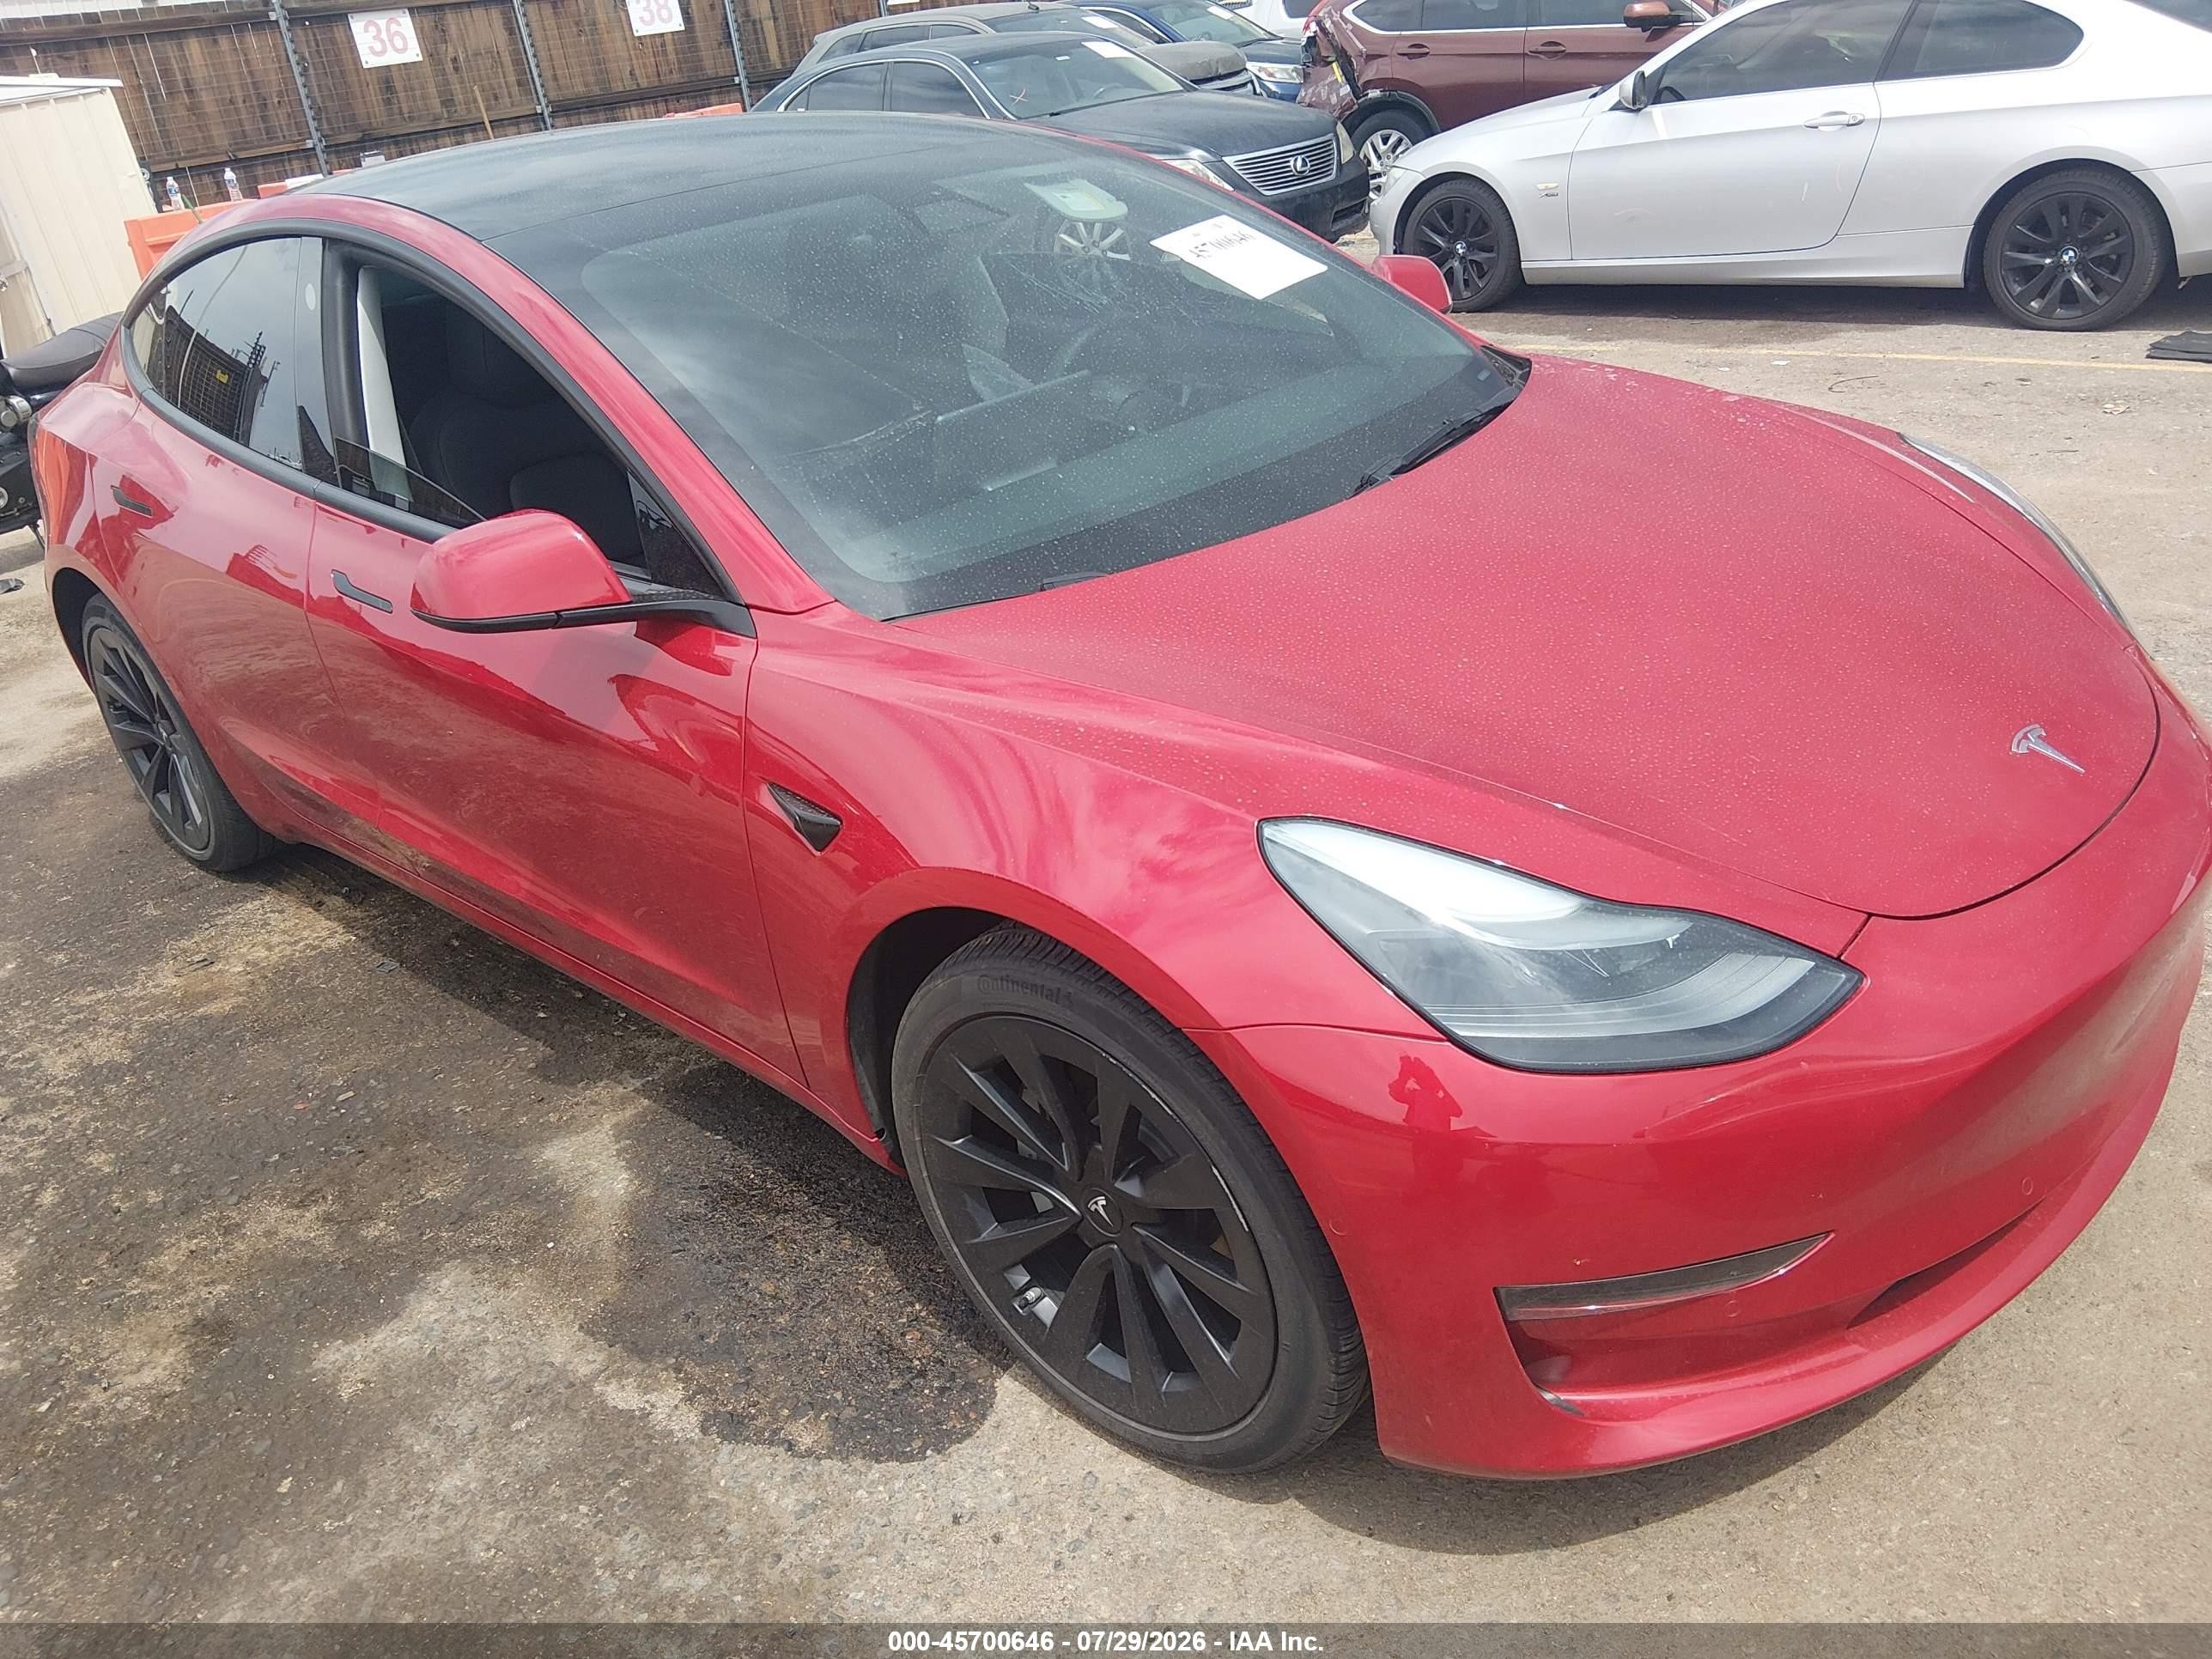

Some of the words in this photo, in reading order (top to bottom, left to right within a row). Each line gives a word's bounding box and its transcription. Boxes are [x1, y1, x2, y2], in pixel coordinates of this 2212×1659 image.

[638, 0, 673, 27] 38
[363, 17, 409, 58] 36
[977, 974, 1060, 1004] Continental
